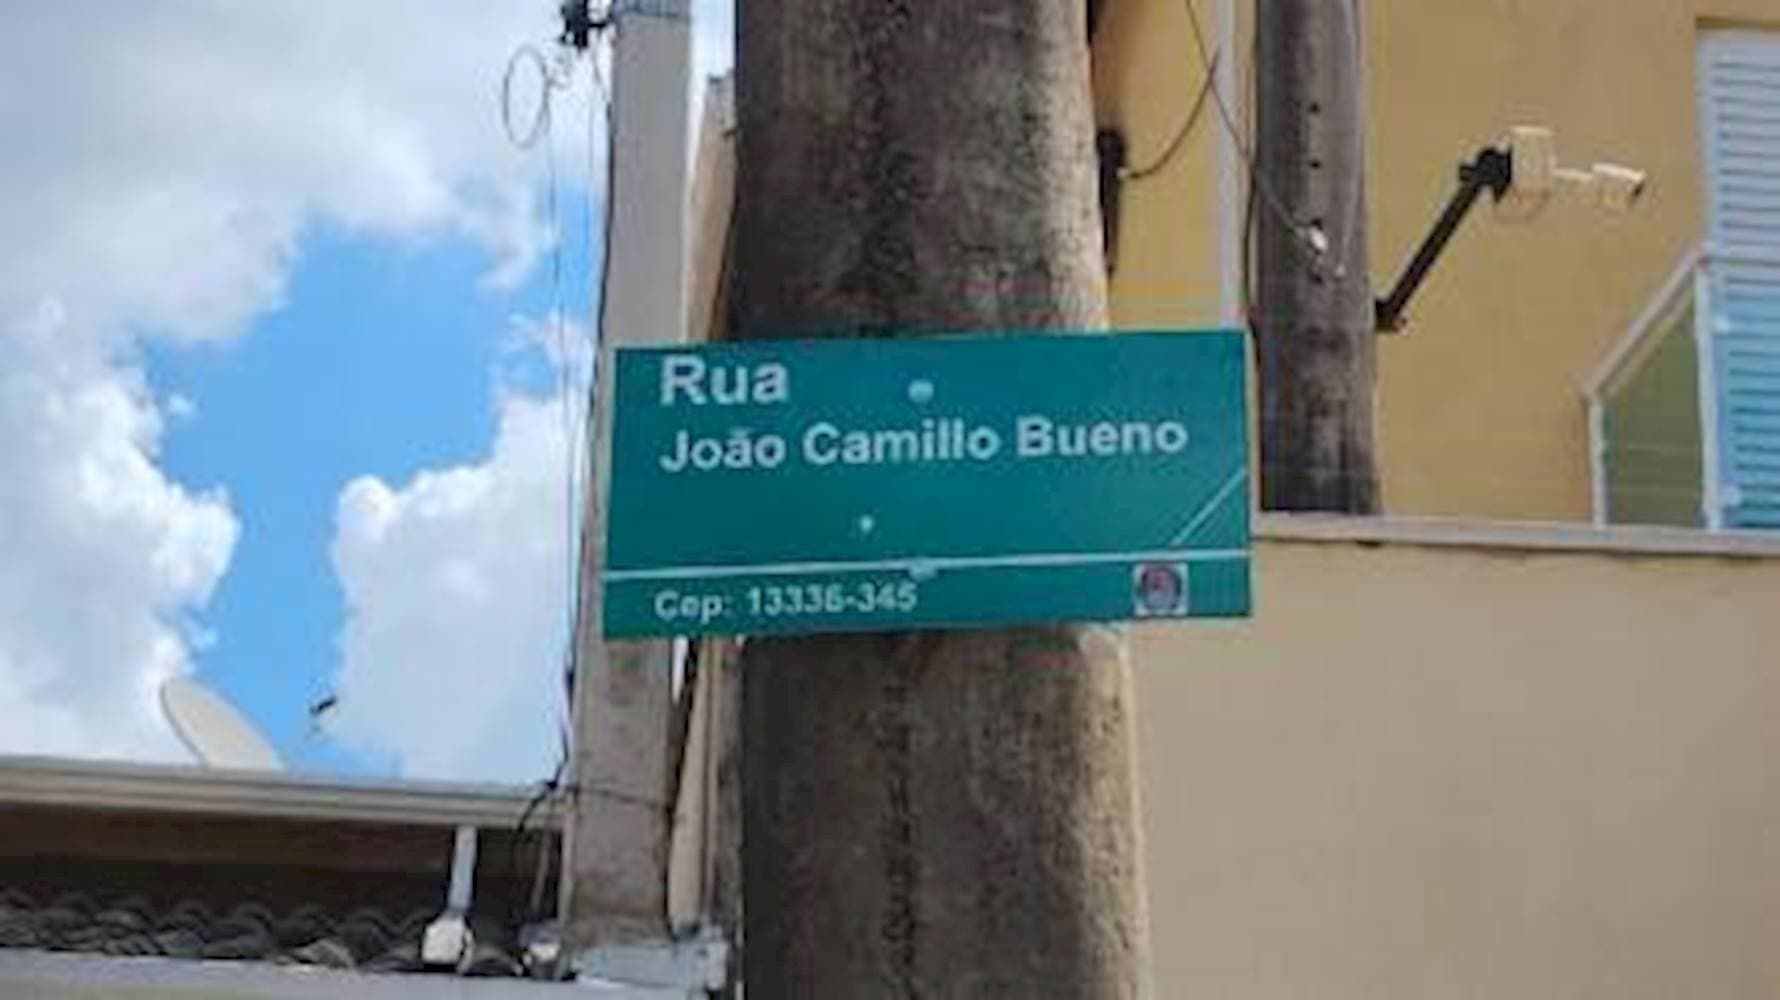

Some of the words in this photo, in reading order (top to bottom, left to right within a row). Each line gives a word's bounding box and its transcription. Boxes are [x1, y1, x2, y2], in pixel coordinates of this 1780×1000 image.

[659, 355, 789, 406] Rua
[659, 426, 787, 474] João
[803, 417, 1000, 466] Camillo
[1016, 415, 1189, 458] Bueno
[654, 590, 732, 624] Cep:
